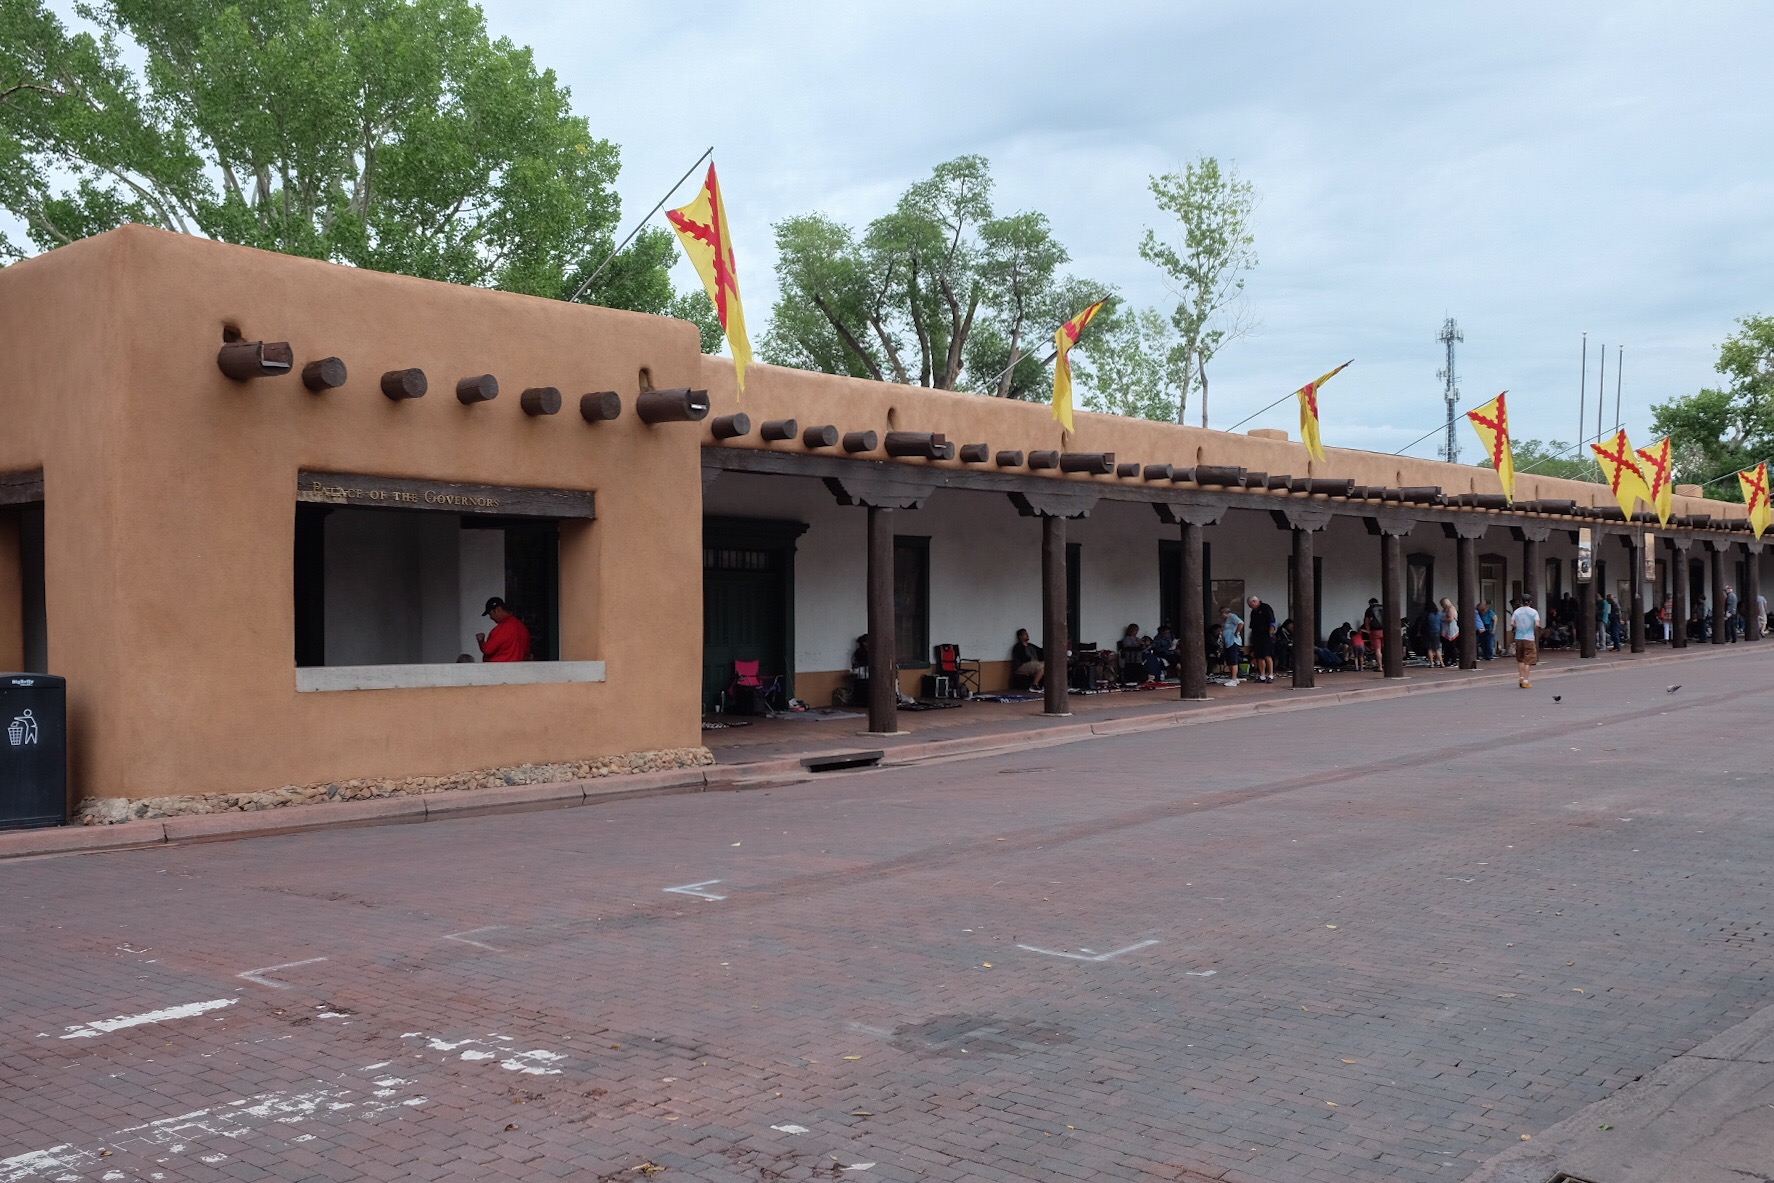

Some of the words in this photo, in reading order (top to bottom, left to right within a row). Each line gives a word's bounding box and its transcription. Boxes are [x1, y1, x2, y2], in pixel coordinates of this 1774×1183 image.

[312, 481, 363, 499] PALACE
[369, 490, 387, 500] OF
[393, 491, 418, 503] THE
[424, 490, 500, 508] GOVERNORS
